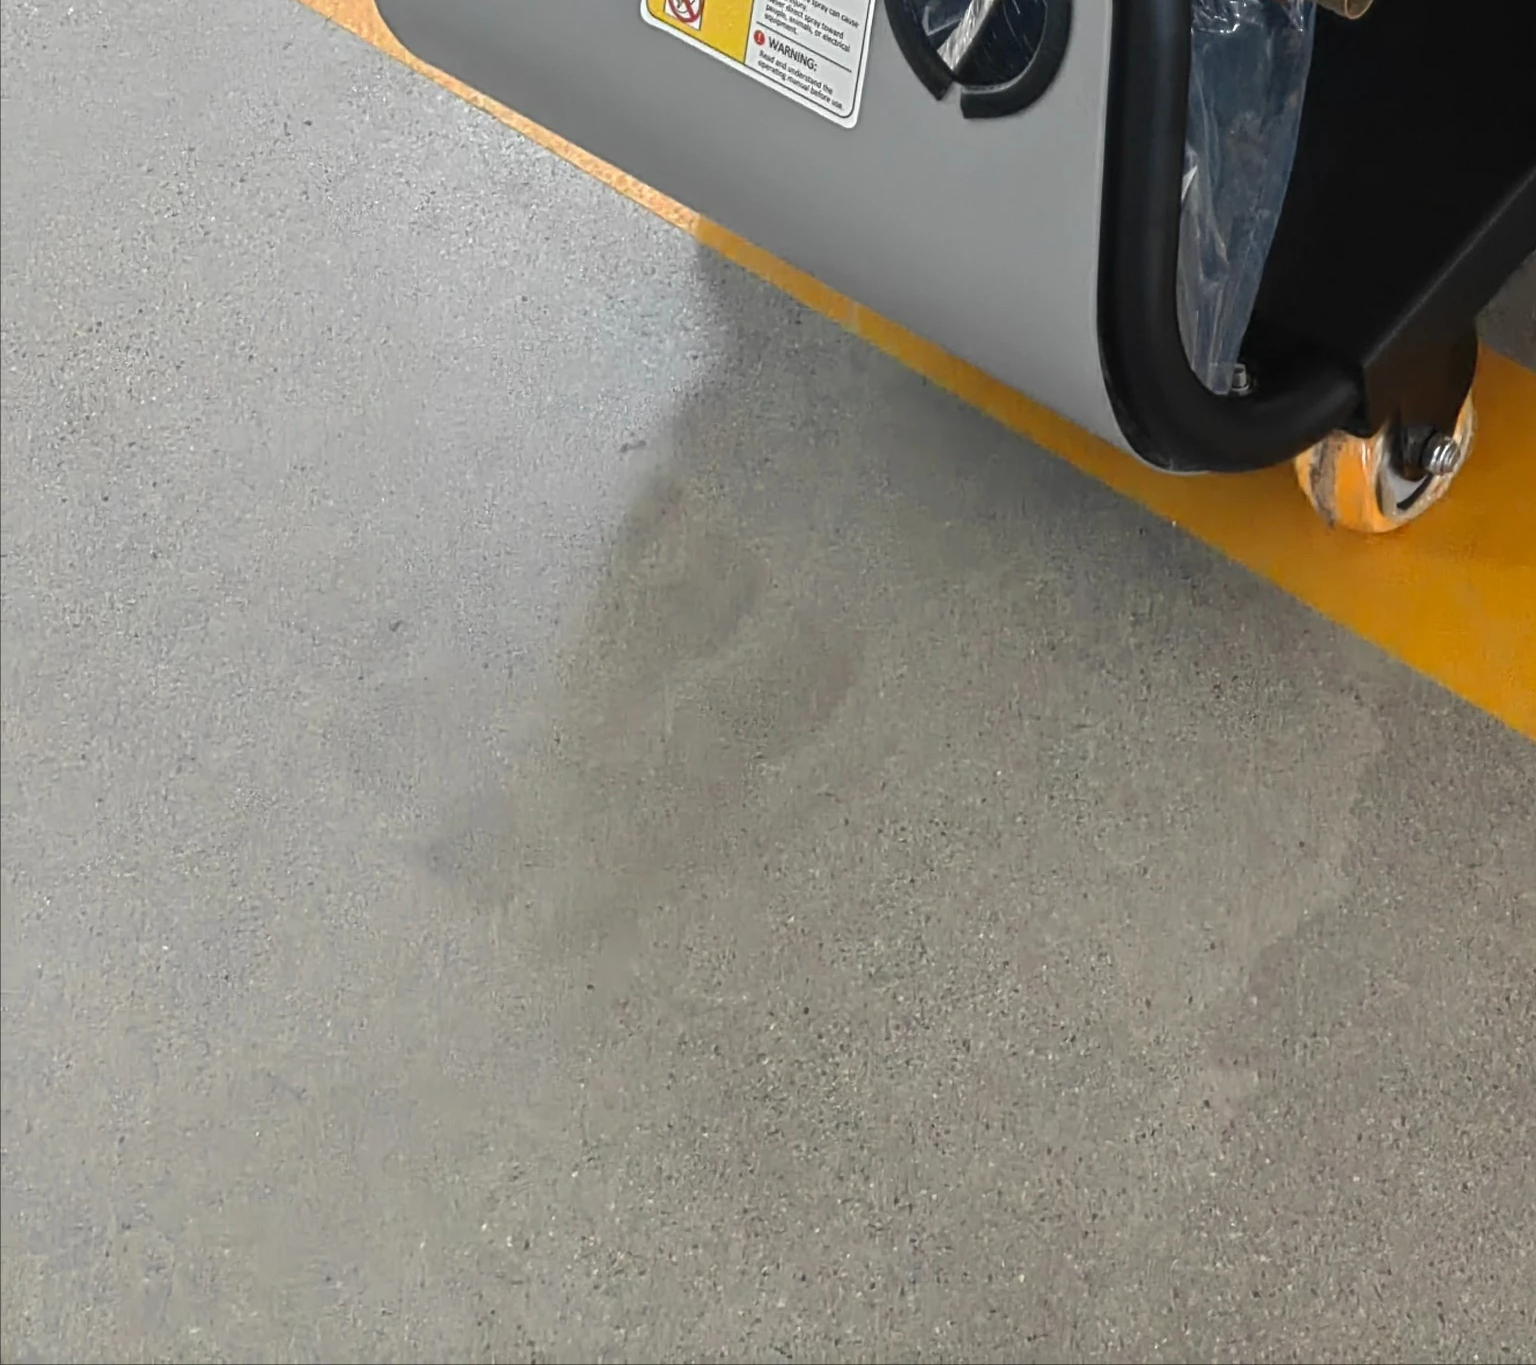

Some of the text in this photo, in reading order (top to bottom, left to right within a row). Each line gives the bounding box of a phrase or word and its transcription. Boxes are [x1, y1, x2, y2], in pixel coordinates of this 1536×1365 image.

[764, 12, 800, 36] equipment.
[765, 4, 852, 53] people, animals, or electrical
[785, 3, 804, 19] direct
[804, 13, 822, 29] spray
[821, 22, 845, 40] toward
[811, 0, 829, 14] spray
[828, 9, 841, 19] can
[841, 14, 860, 29] cause
[759, 49, 834, 96] Read and understand the
[768, 35, 819, 73] WARNING:
[758, 59, 787, 82] operating
[787, 75, 811, 92] manual
[810, 85, 832, 104] before
